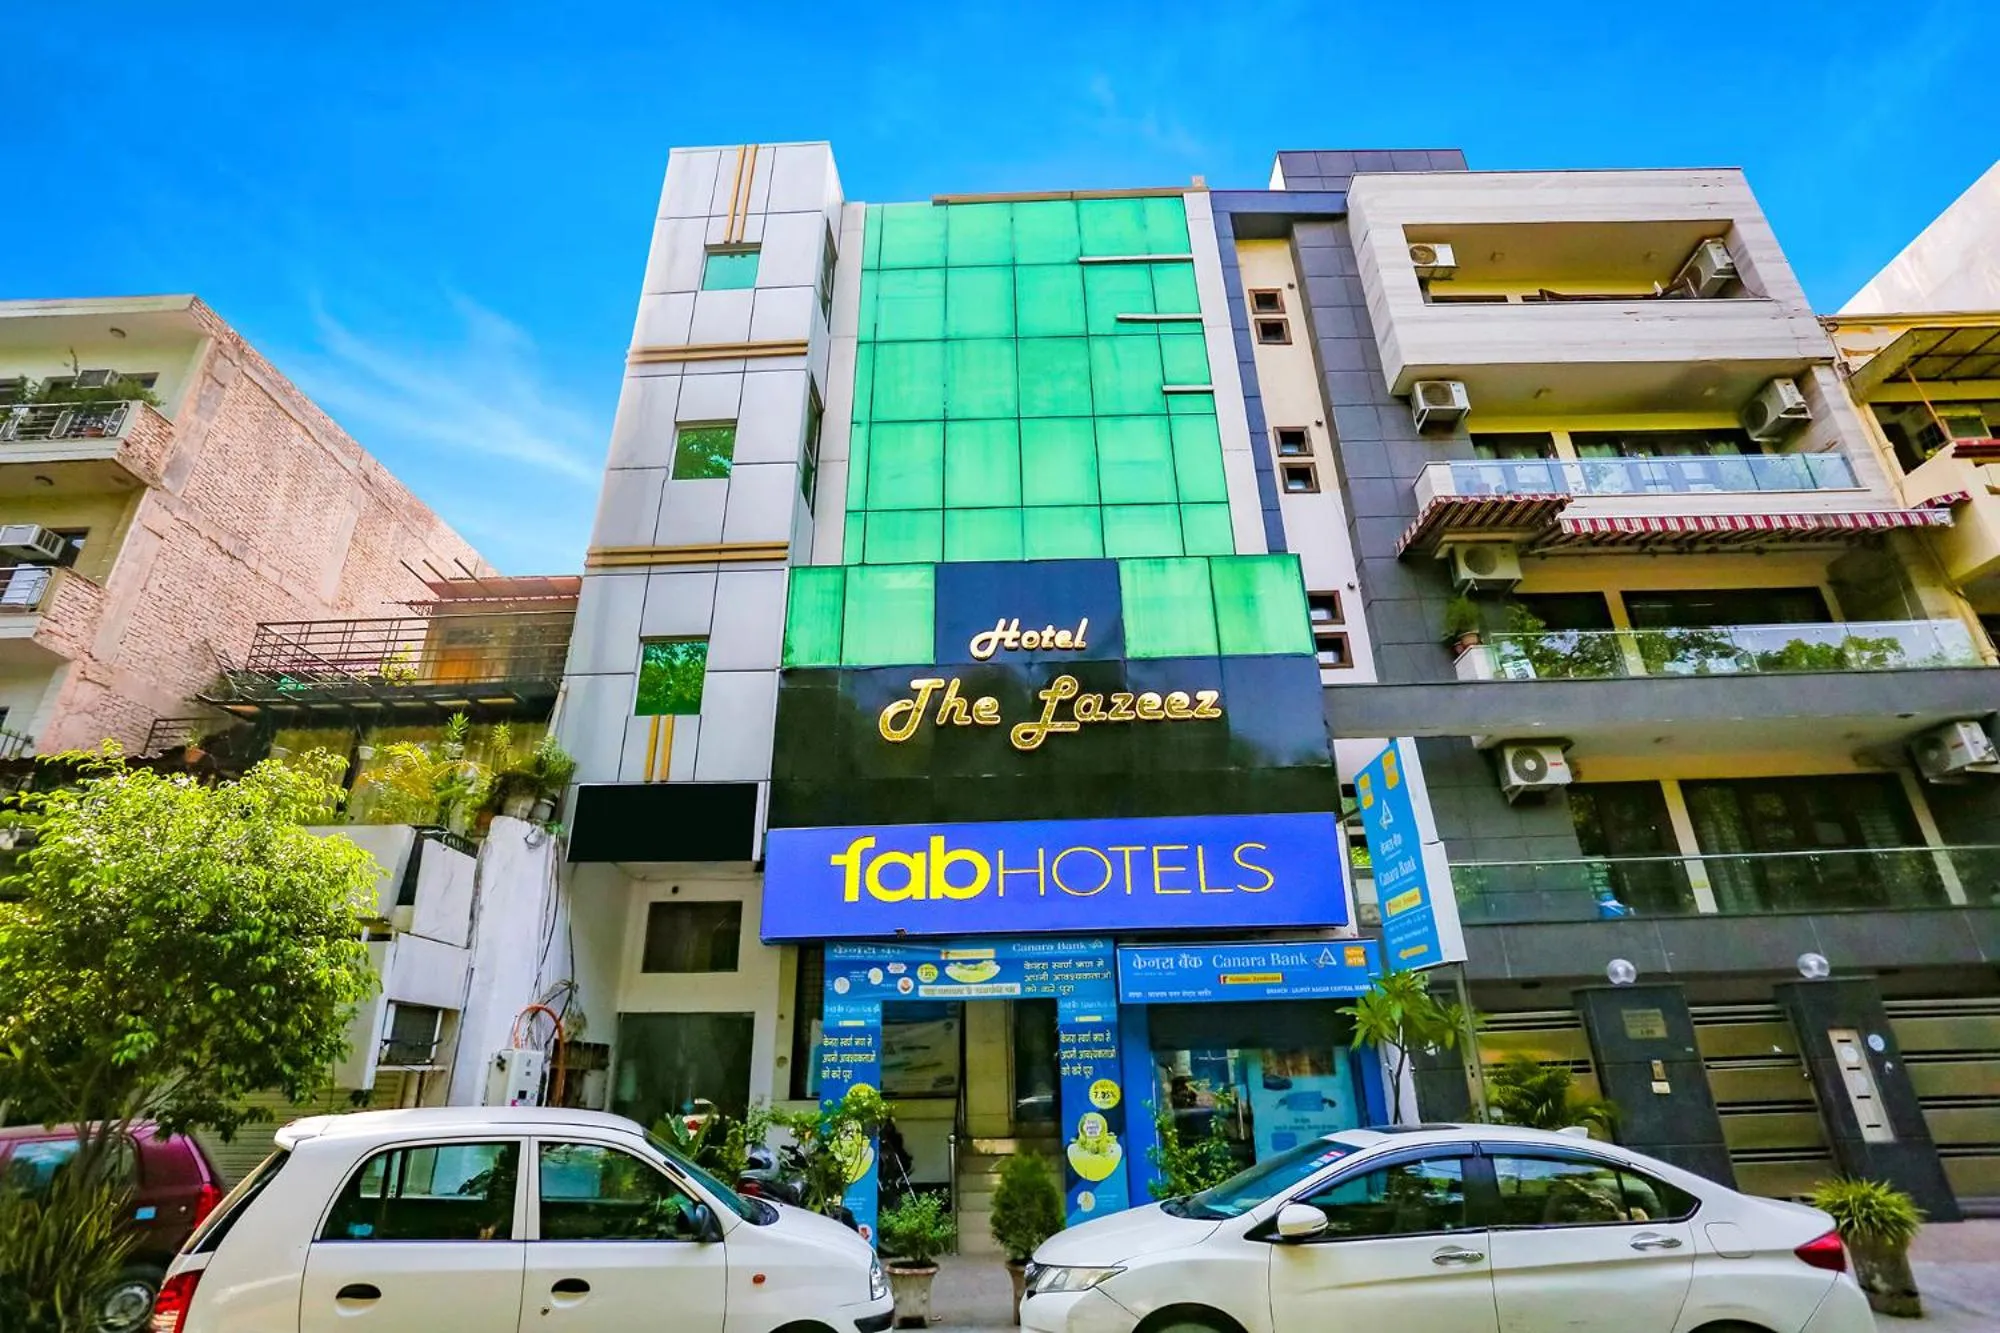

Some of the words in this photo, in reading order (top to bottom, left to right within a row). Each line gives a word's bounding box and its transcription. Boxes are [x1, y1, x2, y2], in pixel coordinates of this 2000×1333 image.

[969, 618, 1088, 660] Hotel
[879, 677, 1001, 742] The
[1010, 675, 1222, 750] Lazeez
[1012, 942, 1054, 952] Canara
[1057, 941, 1086, 950] Bank
[1132, 953, 1174, 970] केनरा
[1179, 952, 1203, 968] बैंक
[1212, 954, 1266, 969] Canara
[1270, 952, 1308, 966] Bank
